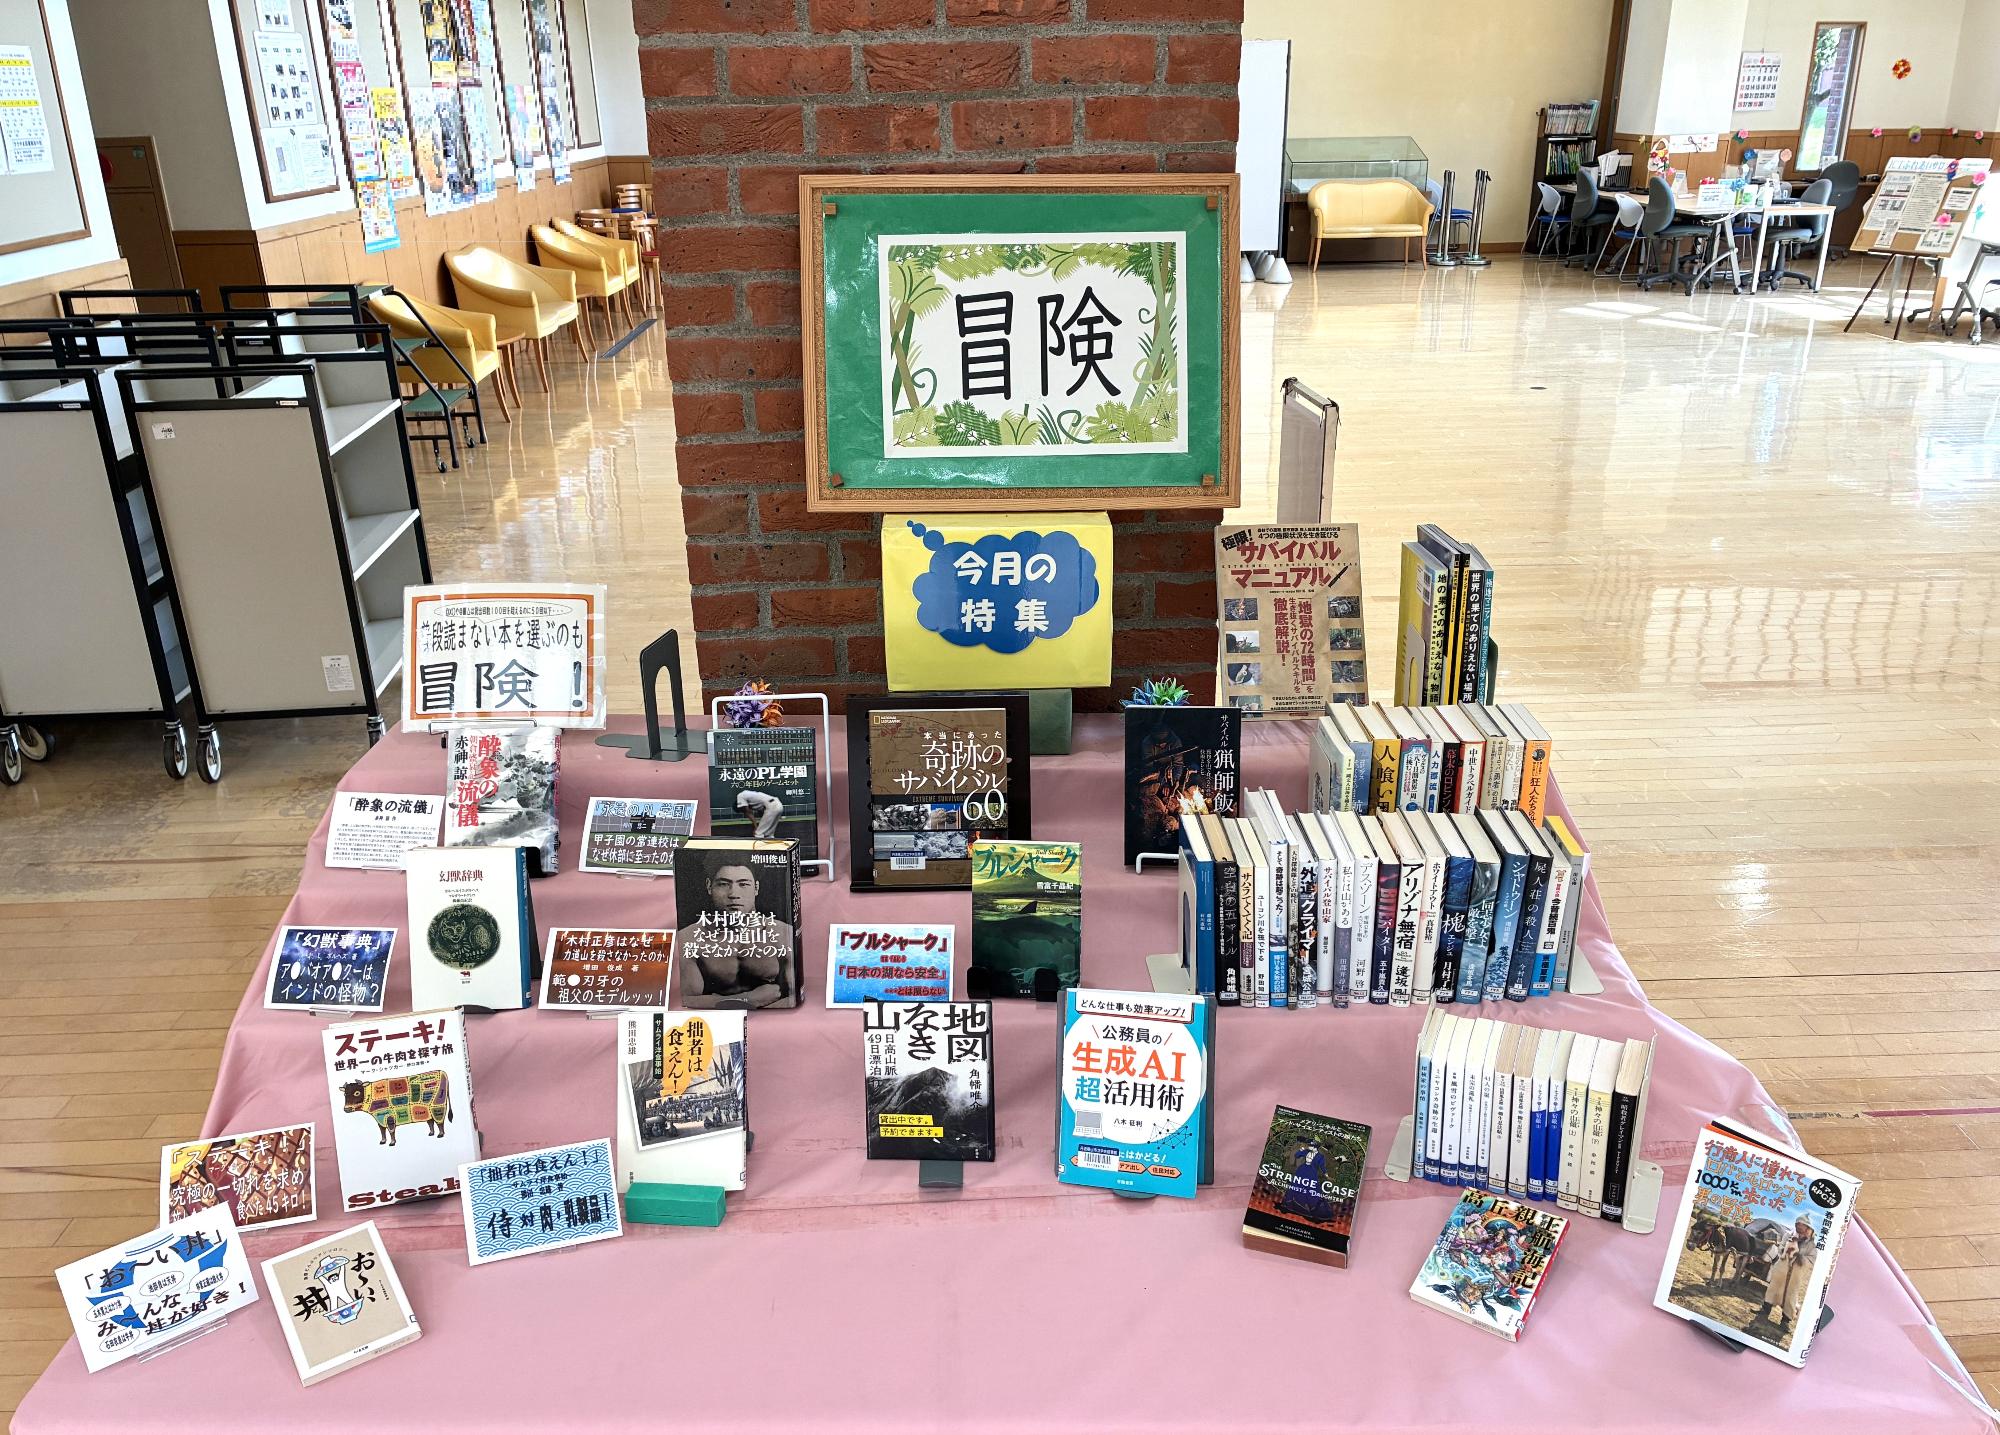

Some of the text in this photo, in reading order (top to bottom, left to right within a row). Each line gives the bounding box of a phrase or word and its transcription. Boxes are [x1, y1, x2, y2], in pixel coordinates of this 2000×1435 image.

[955, 286, 1122, 400] 冒険
[953, 550, 1057, 586] 今月の
[1237, 540, 1341, 563] サバイバル
[1231, 567, 1331, 588] マニュアル
[961, 598, 1049, 633] 特集
[1274, 597, 1291, 666] 徹底解説!
[1430, 574, 1447, 703] 地の果てのありえない物語
[1463, 572, 1481, 702] 世界の果てのありえない場所
[924, 730, 1002, 740] 本当にあった
[454, 735, 468, 780] 赤神諒
[478, 735, 501, 798] 酔象の
[920, 740, 1005, 770] 奇跡の
[719, 765, 807, 782] 永遠のPL学園
[893, 769, 1006, 795] サバイバル
[1213, 749, 1235, 812] 猟師飯
[1465, 748, 1478, 814] 中世トラベルガイド
[349, 797, 434, 815] 「酔象の流儀」
[457, 780, 480, 827] 流儀
[963, 788, 1004, 820] 60
[594, 834, 680, 848] 甲子園の常連校は
[750, 854, 788, 864] 増田俊也
[439, 869, 484, 882] 幻獣辞典
[975, 845, 1078, 879] ブルシャーク
[1322, 867, 1333, 923] サバイバル登山家
[1341, 866, 1352, 926] 私には山がある
[1359, 864, 1373, 915] デスゾーン
[1429, 863, 1441, 910] ホワイトアウト
[1523, 862, 1547, 940] 屍人荘の殺人
[695, 910, 777, 928] 木村政彦は
[1300, 867, 1316, 964] 外道クライマー
[1396, 863, 1424, 950] アリゾナ無宿
[296, 931, 380, 949] 「幻獣事典」
[683, 942, 793, 959] 殺さなかったのか
[693, 926, 780, 945] なぜ力道山を
[1382, 918, 1393, 955] バイター
[563, 949, 669, 964] 力道山を殺さなかったのか」
[1516, 962, 1526, 984] 今村昌
[281, 981, 379, 1003] インドの怪物?
[1226, 967, 1237, 992] 角幡唯
[864, 1001, 900, 1033] 山
[1080, 999, 1186, 1018] どんな仕事も効率アップ!
[334, 1018, 446, 1057] ステーキ!
[686, 1021, 705, 1073] 拙者は
[903, 1003, 940, 1061] なき
[942, 1003, 990, 1064] 地図
[1102, 1024, 1163, 1045] 公務員の
[334, 1043, 454, 1072] 世界一の牛肉を探す旅
[667, 1028, 684, 1094] 食えん!
[867, 1033, 882, 1088] 49日漂泊行
[884, 1033, 898, 1076] 日高山脈
[1072, 1041, 1187, 1083] 生成AI
[969, 1068, 983, 1110] 角幡唯介
[1075, 1075, 1184, 1112] 超活用術
[880, 1115, 929, 1125] 貸出中です。
[881, 1127, 939, 1137] 予約できます。
[480, 1150, 600, 1184] 「拙者は食えん!」
[1259, 1163, 1356, 1198] STRANGE CASE
[172, 1169, 304, 1206] 究極の一切れを求め
[293, 1286, 331, 1323] 丼
